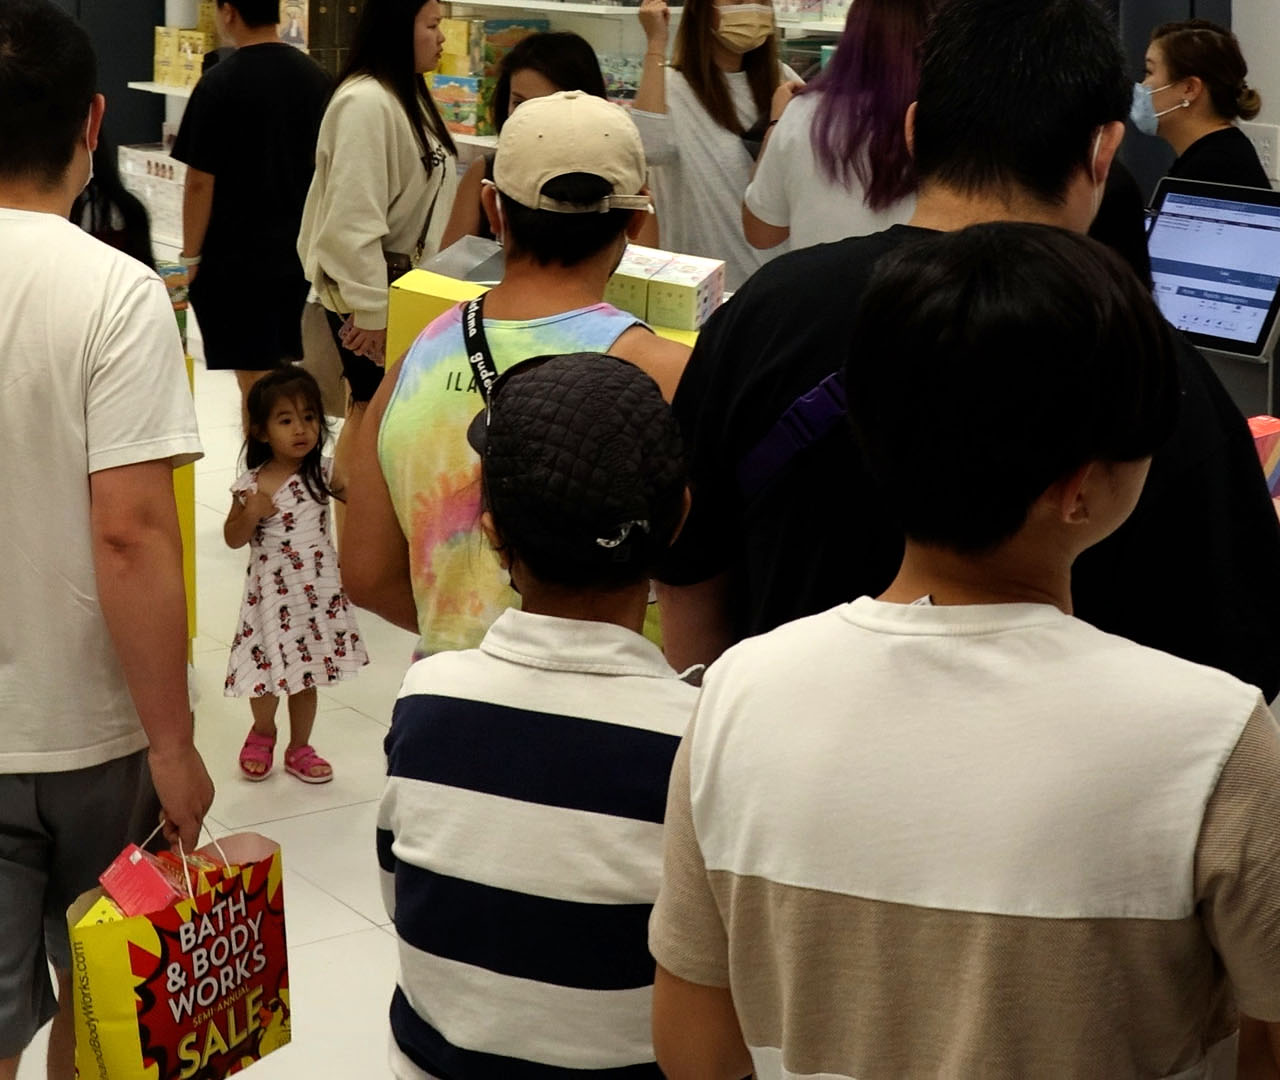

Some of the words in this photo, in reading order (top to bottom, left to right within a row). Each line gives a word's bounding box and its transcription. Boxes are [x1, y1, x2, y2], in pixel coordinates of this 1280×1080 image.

[166, 962, 187, 993] &
[192, 911, 263, 980] BODY
[179, 889, 247, 954] BATH
[168, 943, 266, 1024] WORKS
[177, 984, 264, 1080] SALE
